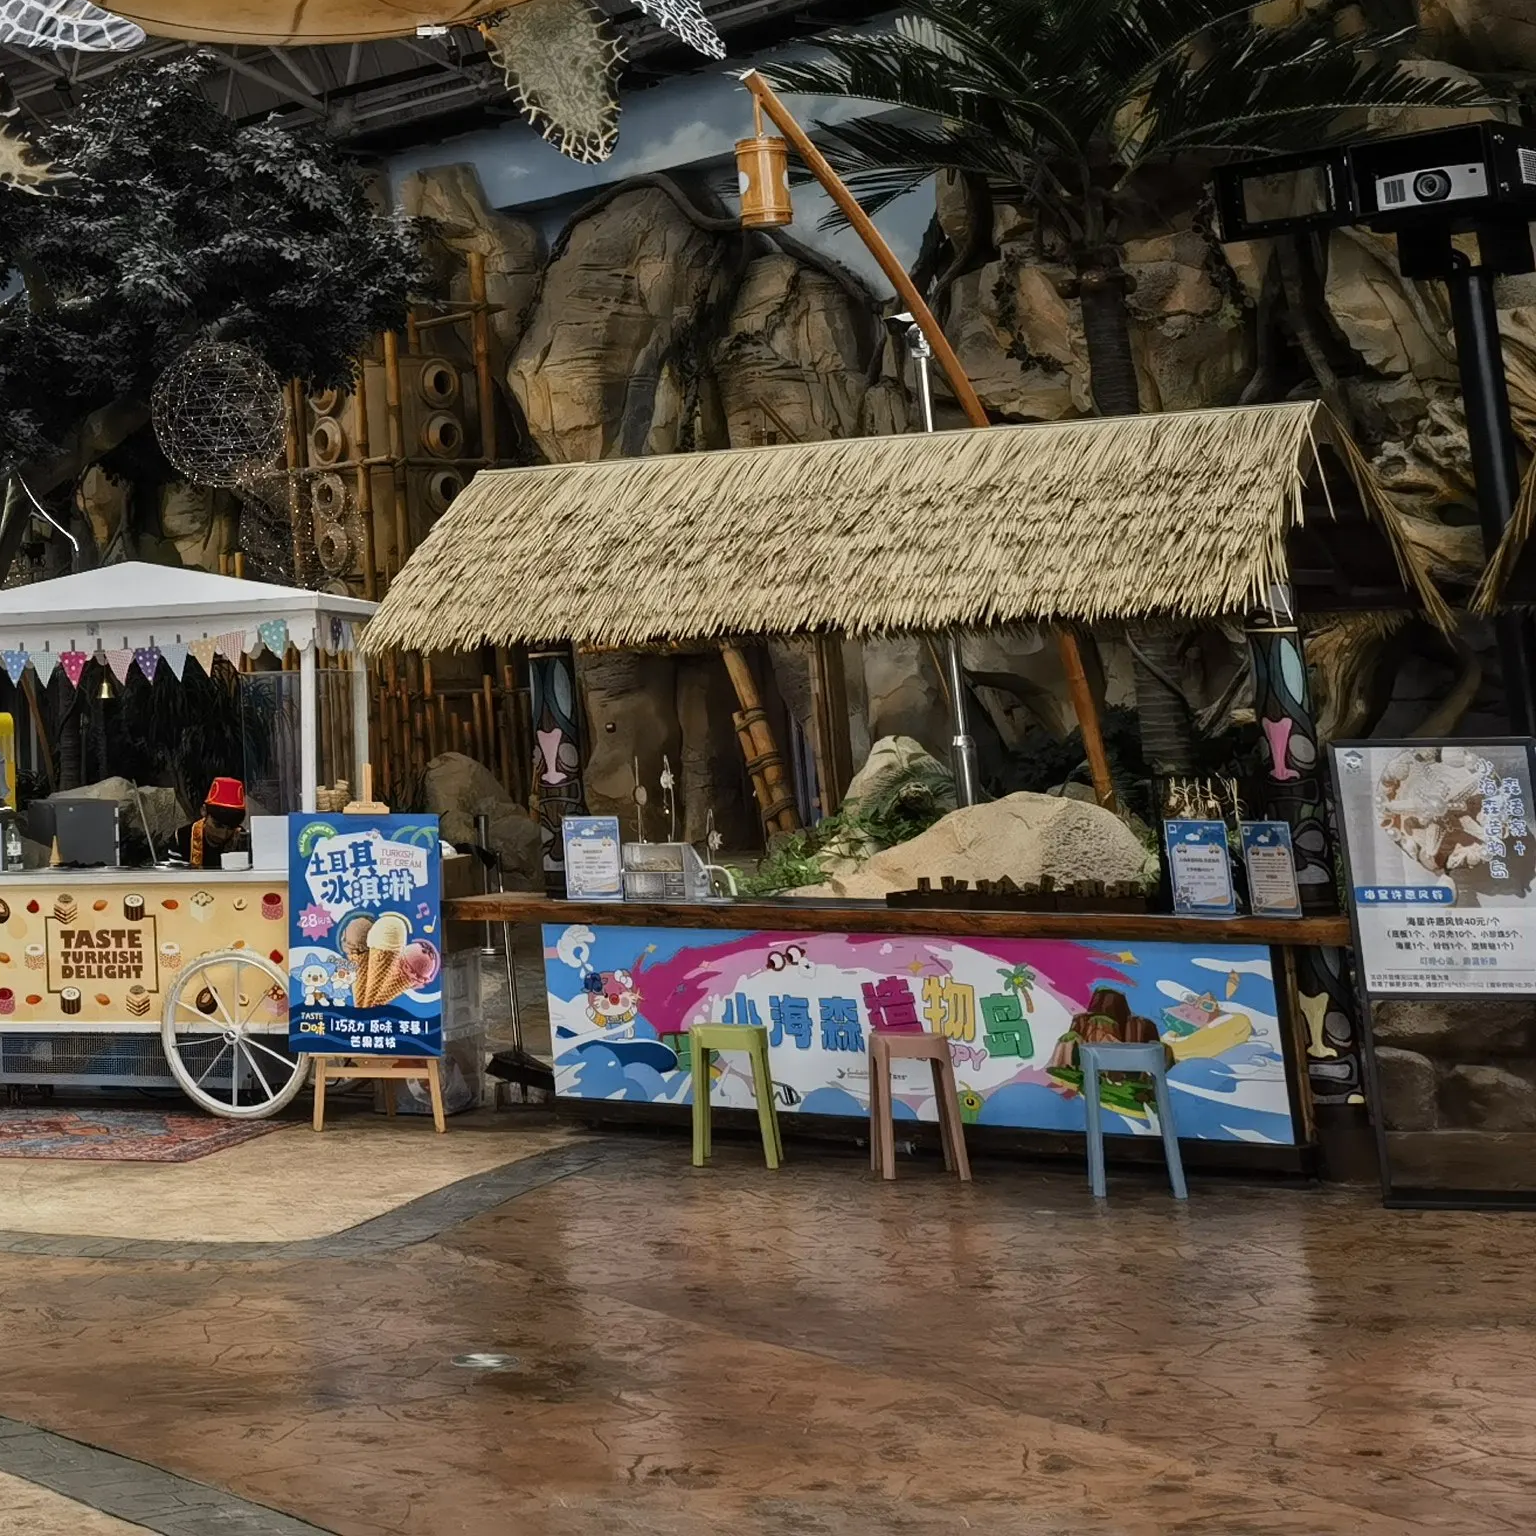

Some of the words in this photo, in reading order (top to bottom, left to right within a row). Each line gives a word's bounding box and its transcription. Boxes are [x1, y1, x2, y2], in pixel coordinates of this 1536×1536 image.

[310, 840, 377, 877] 土耳其
[381, 849, 414, 858] TURKISH
[380, 858, 392, 866] ICE
[394, 859, 422, 869] CREAM
[321, 869, 416, 907] 冰淇淋
[1364, 890, 1443, 901] 海星许愿风铃
[60, 929, 142, 949] TASTE
[61, 951, 143, 964] TURKISH
[62, 965, 143, 979] DELIGHT
[301, 1012, 324, 1020] TASTE
[721, 975, 1035, 1059] 小海森造物岛
[300, 1021, 326, 1035] 口味
[335, 1019, 365, 1033] 巧克力
[370, 1020, 393, 1033] 原味
[398, 1020, 422, 1034] 草莓
[350, 1035, 396, 1049] 芒果荔枝
